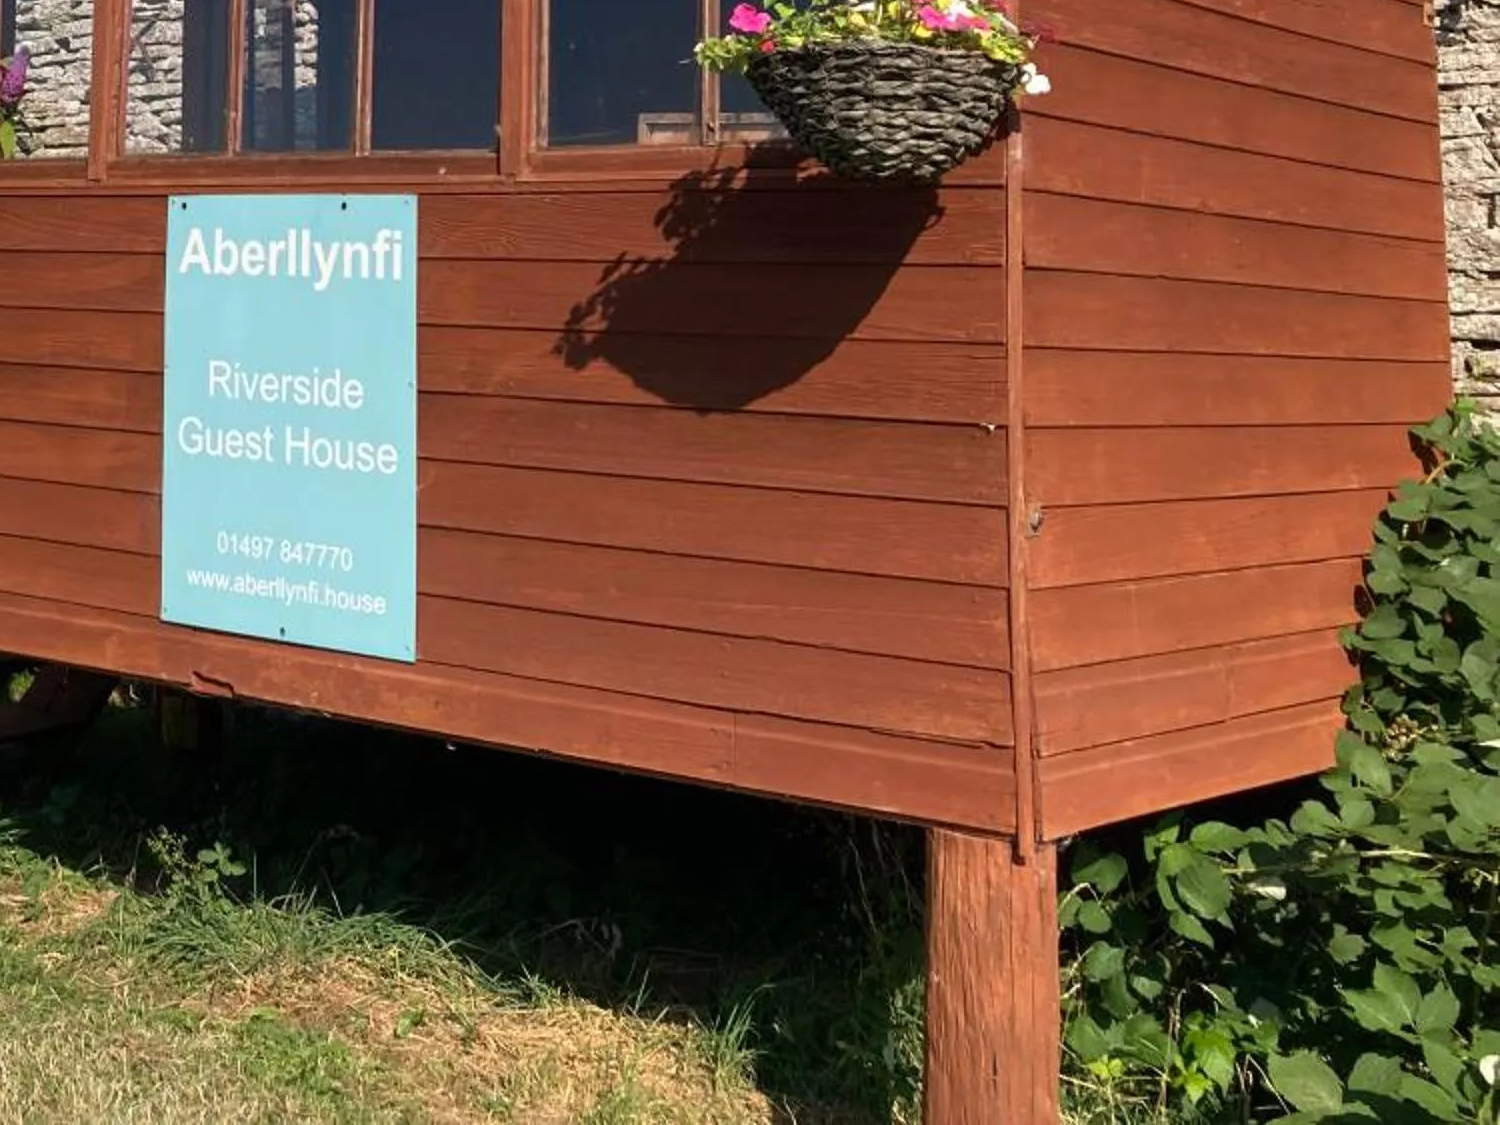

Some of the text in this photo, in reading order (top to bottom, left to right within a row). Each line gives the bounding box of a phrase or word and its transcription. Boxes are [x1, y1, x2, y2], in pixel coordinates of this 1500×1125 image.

[179, 227, 403, 291] Aberllynfi
[208, 359, 365, 410] Riverside
[178, 416, 399, 475] Guest House
[216, 530, 354, 572] 01497 847770
[186, 568, 388, 615] www.aberllynfi.house
